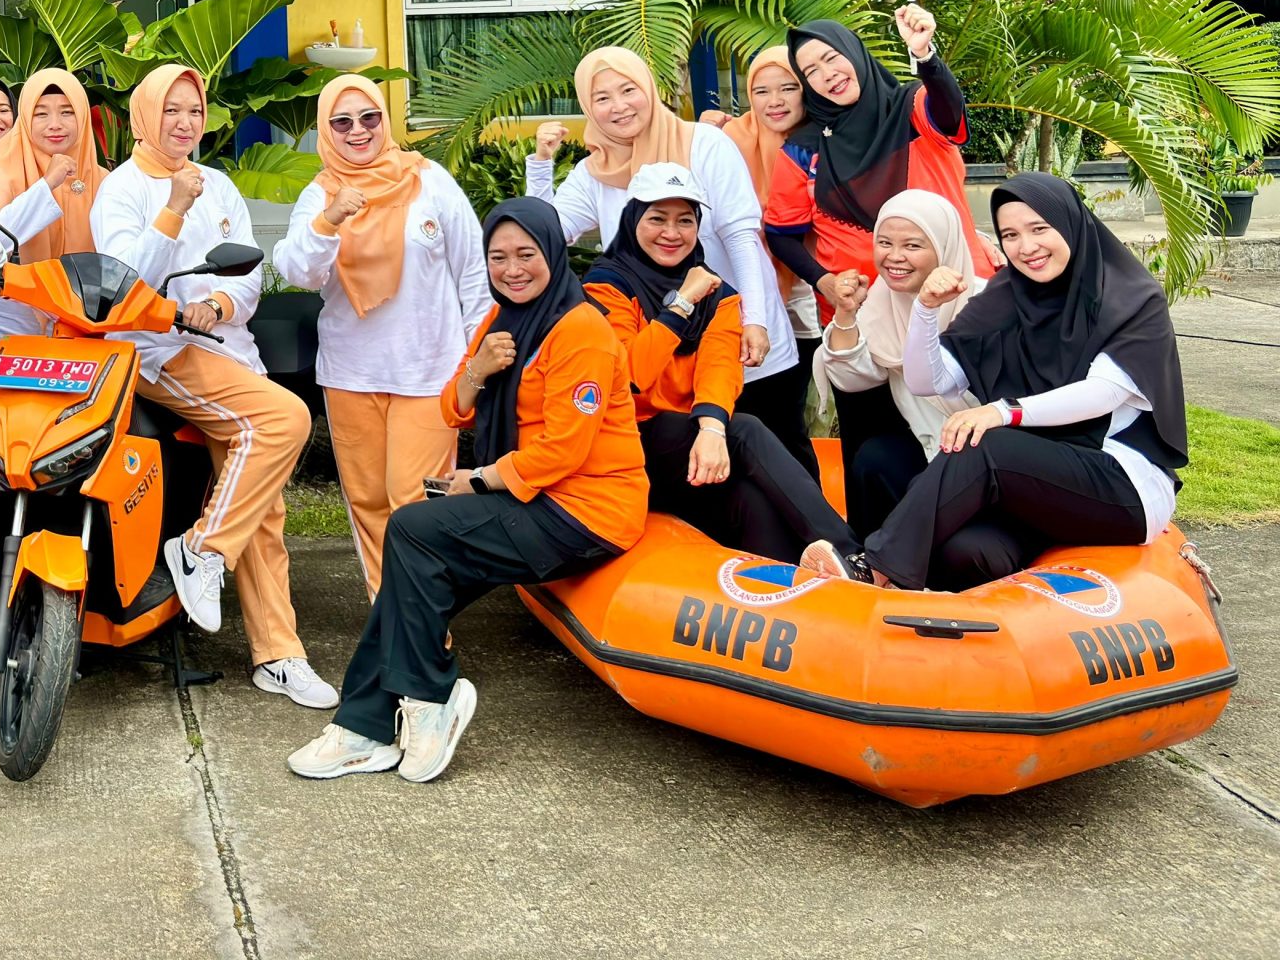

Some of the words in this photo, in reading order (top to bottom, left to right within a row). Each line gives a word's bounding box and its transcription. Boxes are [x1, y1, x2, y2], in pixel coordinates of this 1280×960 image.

[10, 358, 56, 372] 5013
[60, 361, 94, 376] TWO
[124, 463, 159, 515] GESITS
[723, 560, 773, 602] PENANGGULANGAN
[672, 595, 798, 672] BNPB
[1068, 619, 1175, 686] BNPB
